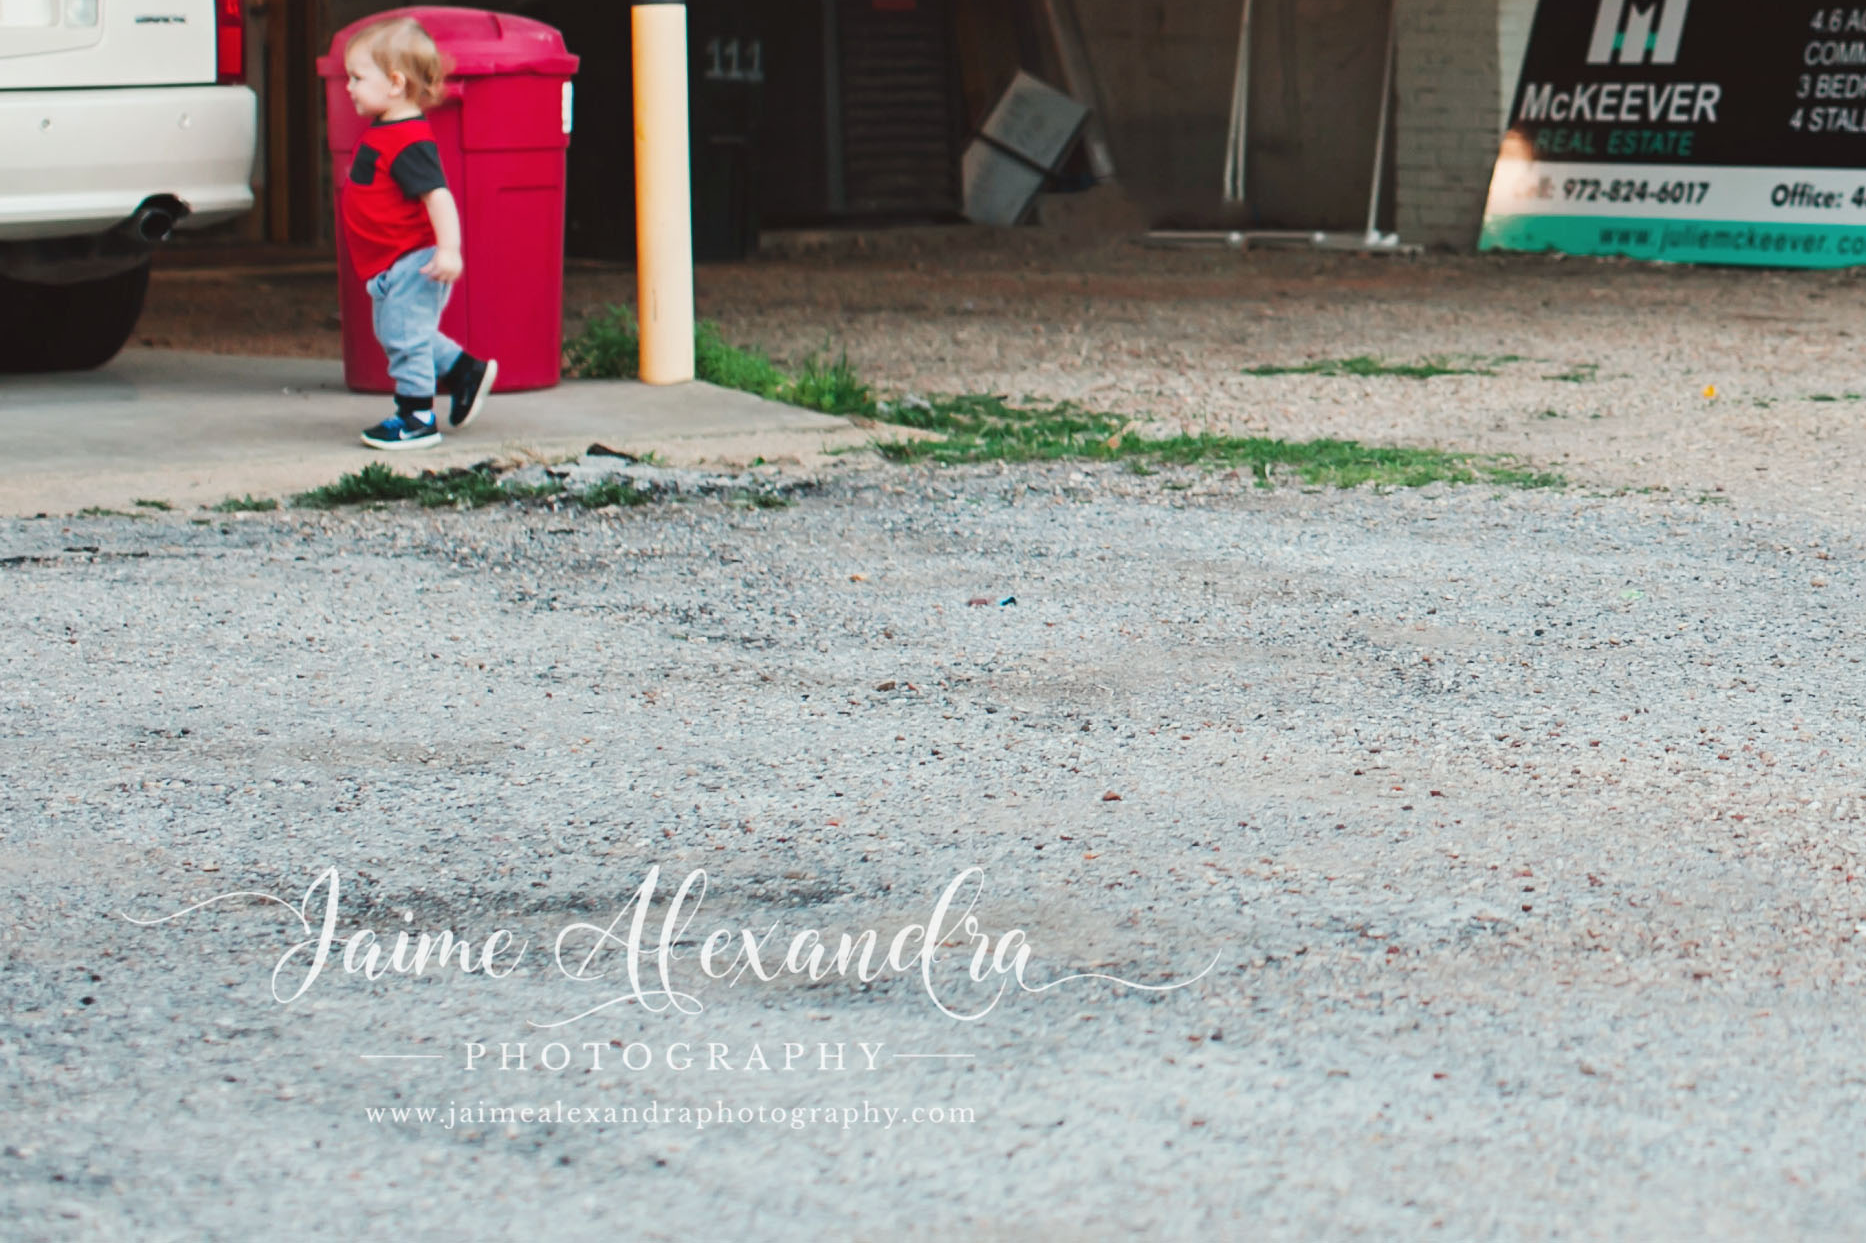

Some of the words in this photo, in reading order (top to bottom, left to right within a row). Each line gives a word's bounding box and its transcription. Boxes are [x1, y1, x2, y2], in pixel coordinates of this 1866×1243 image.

[1810, 8, 1843, 33] 4.6
[705, 39, 763, 82] 111
[1796, 74, 1812, 100] 3
[1519, 83, 1721, 124] McKEEVER
[1789, 108, 1804, 132] 4
[1536, 129, 1593, 155] REAL
[1606, 130, 1694, 157] ESTATE
[1563, 178, 1711, 205] 972-824-6017
[1771, 182, 1844, 209] Office:
